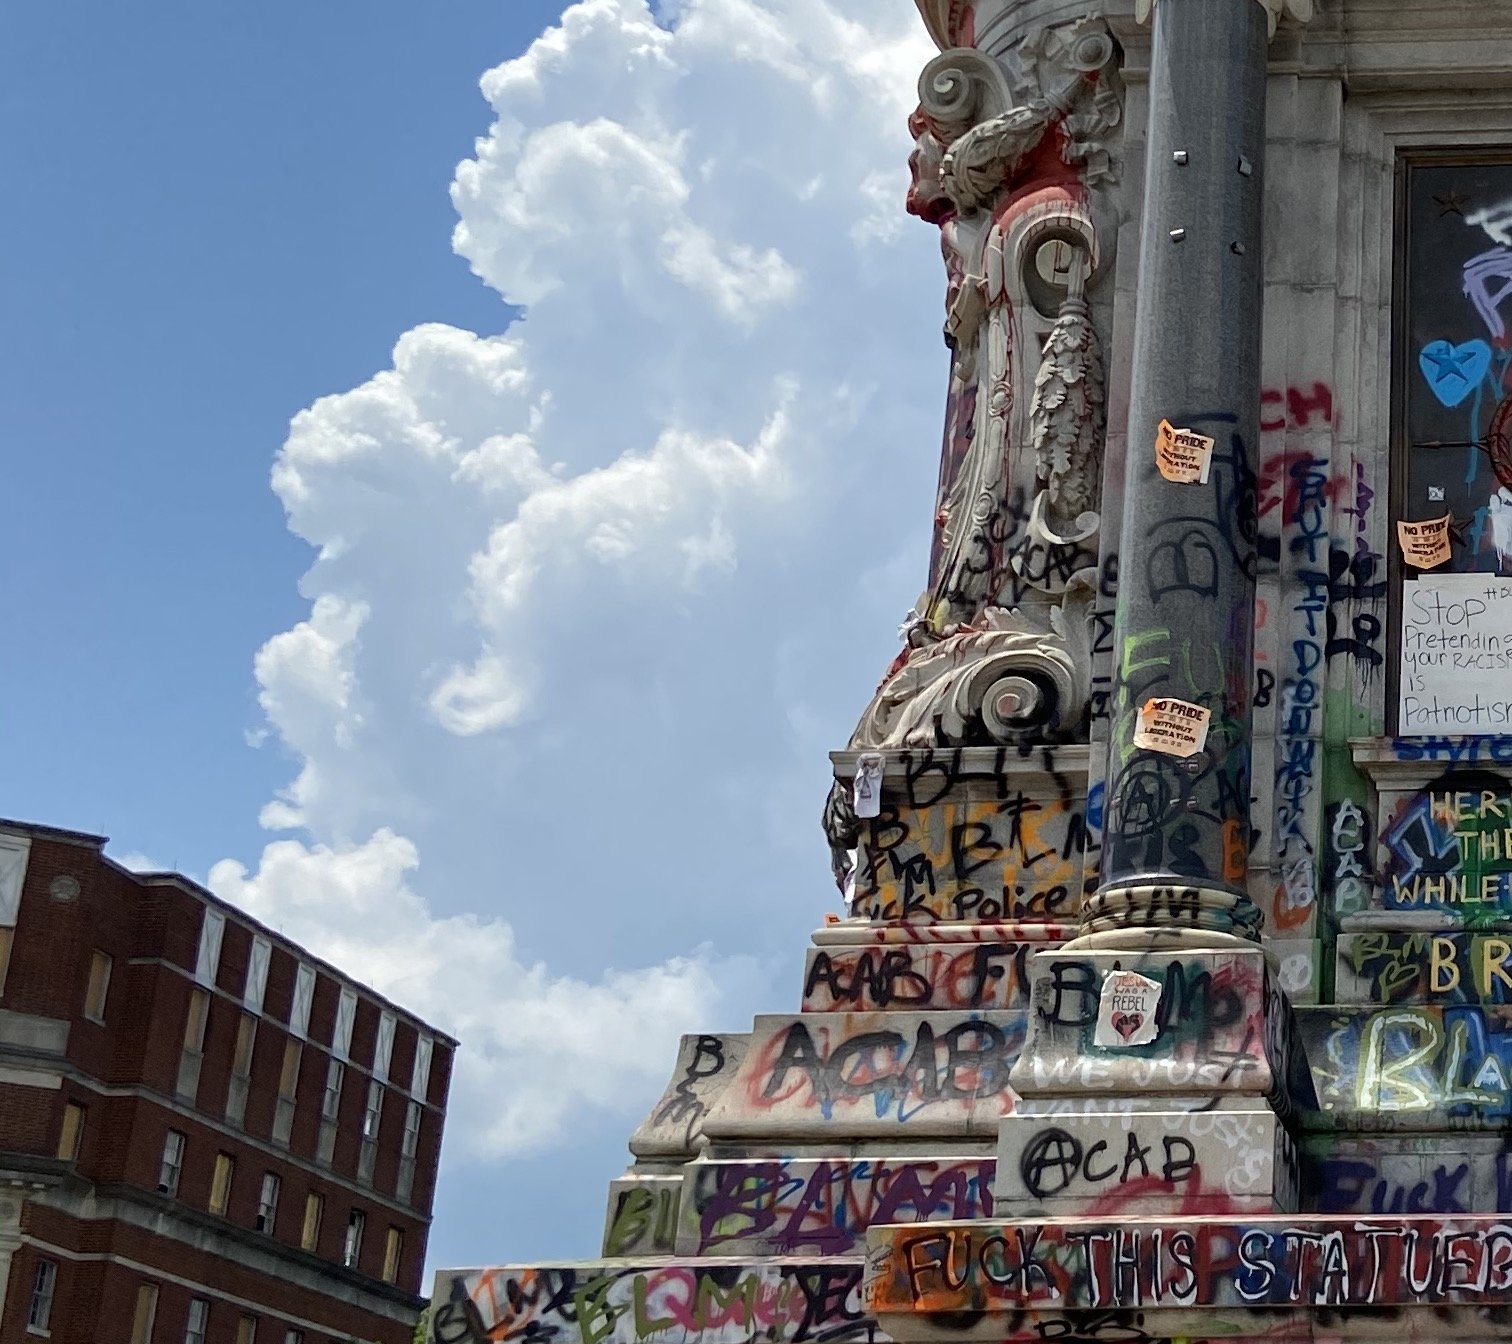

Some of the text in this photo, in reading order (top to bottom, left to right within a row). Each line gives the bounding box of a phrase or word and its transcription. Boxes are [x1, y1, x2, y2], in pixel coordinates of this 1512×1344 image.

[1175, 434, 1207, 450] PRIDE
[1403, 525, 1418, 535] NO
[1404, 652, 1448, 673] your
[1170, 702, 1205, 722] PRIDE
[1145, 727, 1196, 744] LIBERATION
[1153, 719, 1193, 734] WITHOUT
[1392, 873, 1499, 905] WHILE
[953, 885, 1077, 921] Police
[1112, 996, 1148, 1011] REBEL
[903, 1224, 1059, 1306] FUCK
[1066, 1227, 1198, 1305] THIS
[1234, 1220, 1476, 1303] STATUE
